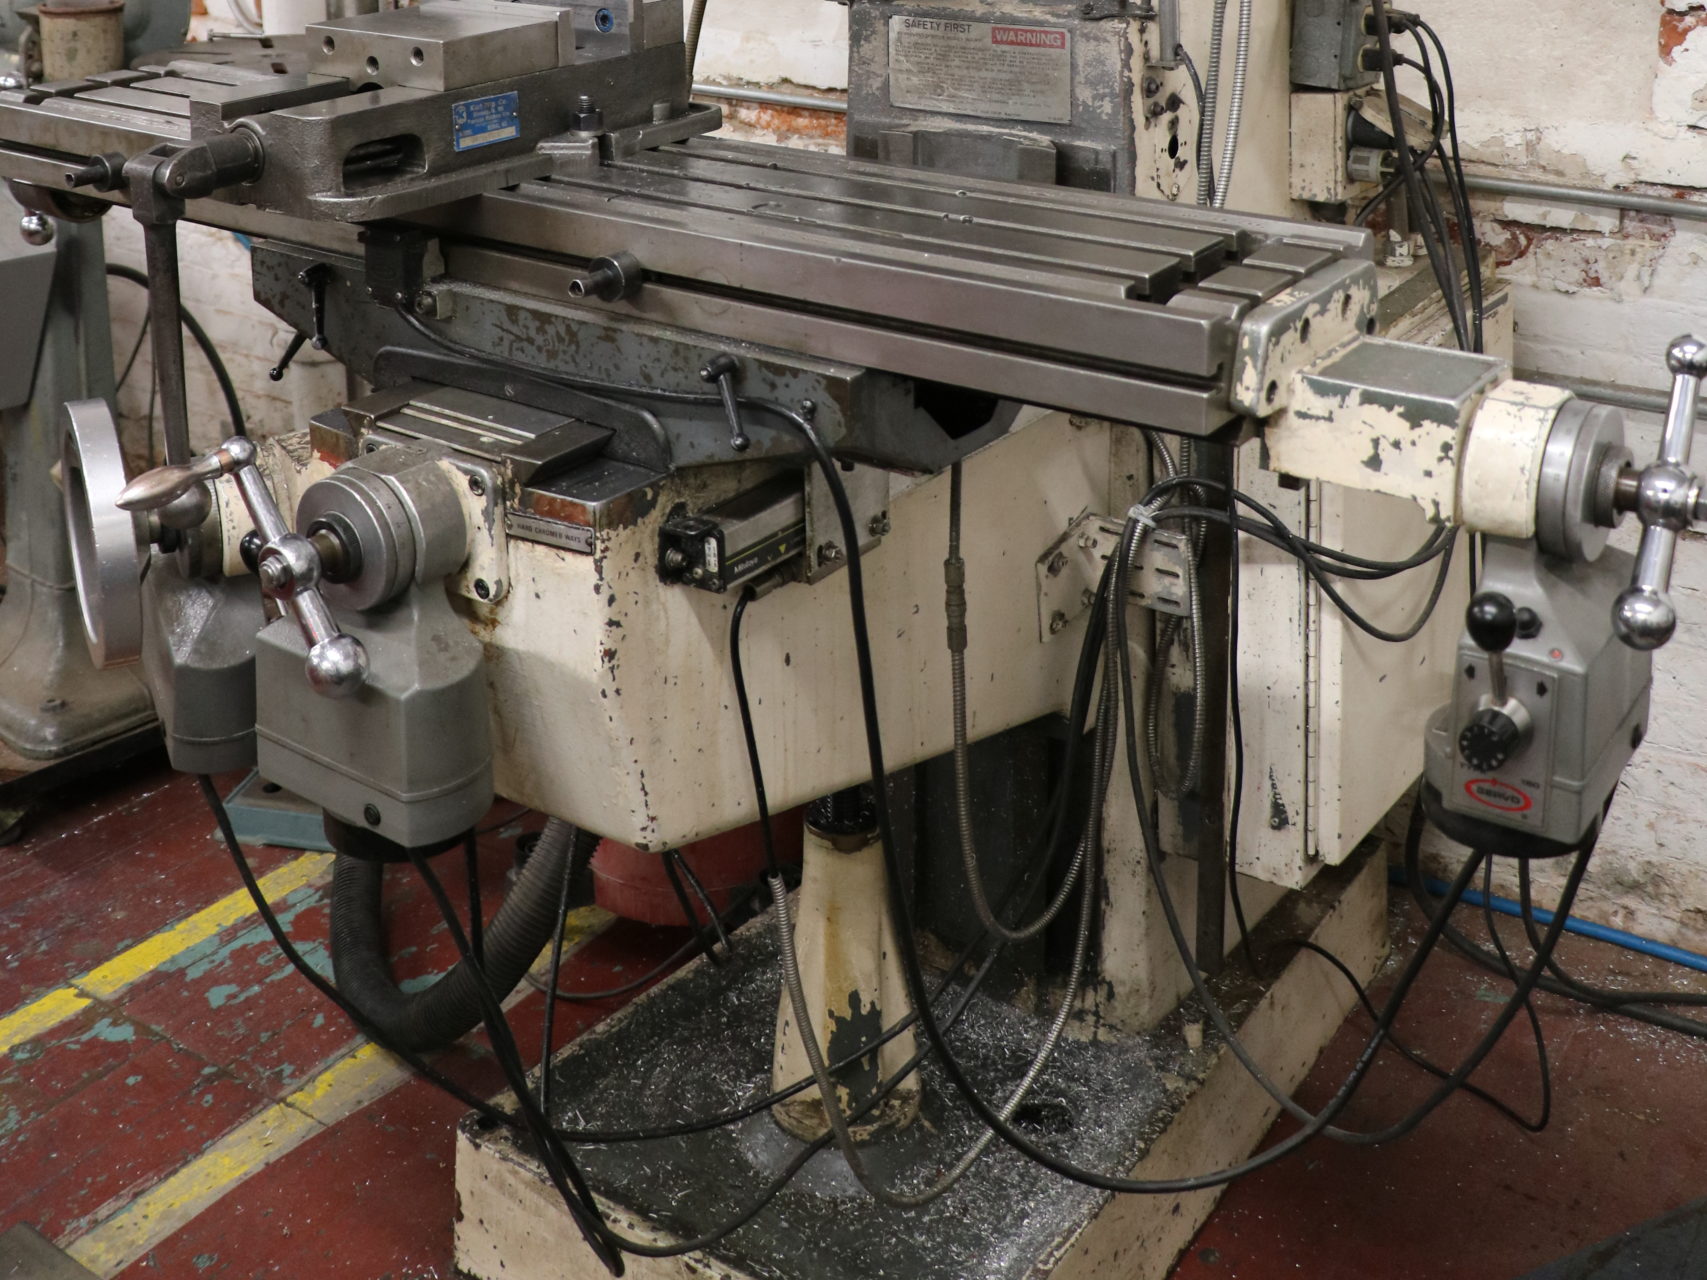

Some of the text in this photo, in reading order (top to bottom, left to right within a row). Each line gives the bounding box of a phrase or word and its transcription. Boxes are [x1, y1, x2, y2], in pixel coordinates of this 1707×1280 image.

[904, 18, 941, 32] SAFETY
[944, 22, 972, 34] FIRST
[994, 30, 1063, 46] WARNING
